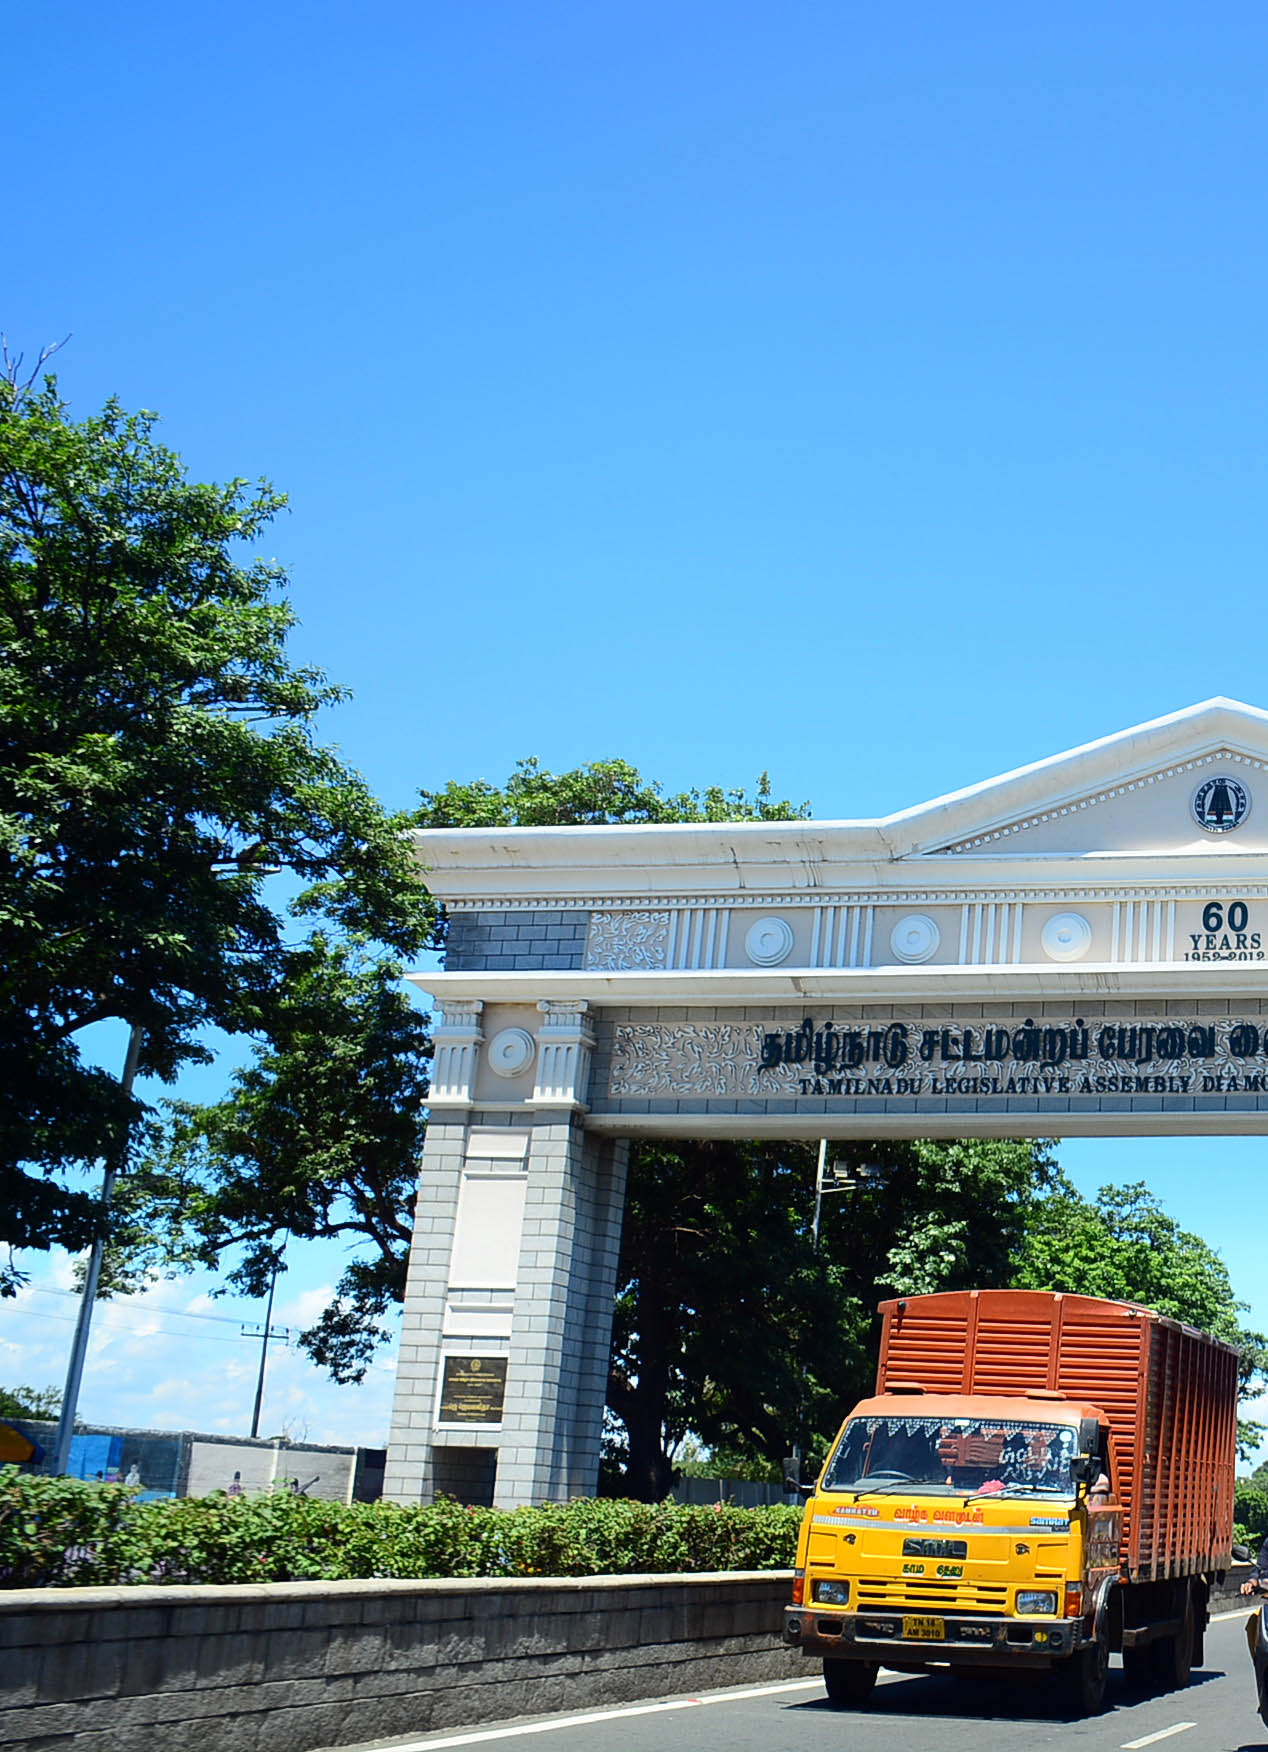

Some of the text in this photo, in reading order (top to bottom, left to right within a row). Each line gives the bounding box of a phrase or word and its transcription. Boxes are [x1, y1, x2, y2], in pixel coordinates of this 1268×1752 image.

[1202, 901, 1249, 933] 60
[1189, 933, 1262, 951] YEARS
[759, 1017, 908, 1075] தமிழ்நாடு
[919, 1018, 1089, 1073] சட்டமன்றப்
[1100, 1025, 1216, 1066] பேரவை
[799, 1077, 923, 1096] TAMILNADU
[931, 1076, 1071, 1095] LEGISLATIVE
[1079, 1075, 1192, 1094] ASSEMBLY
